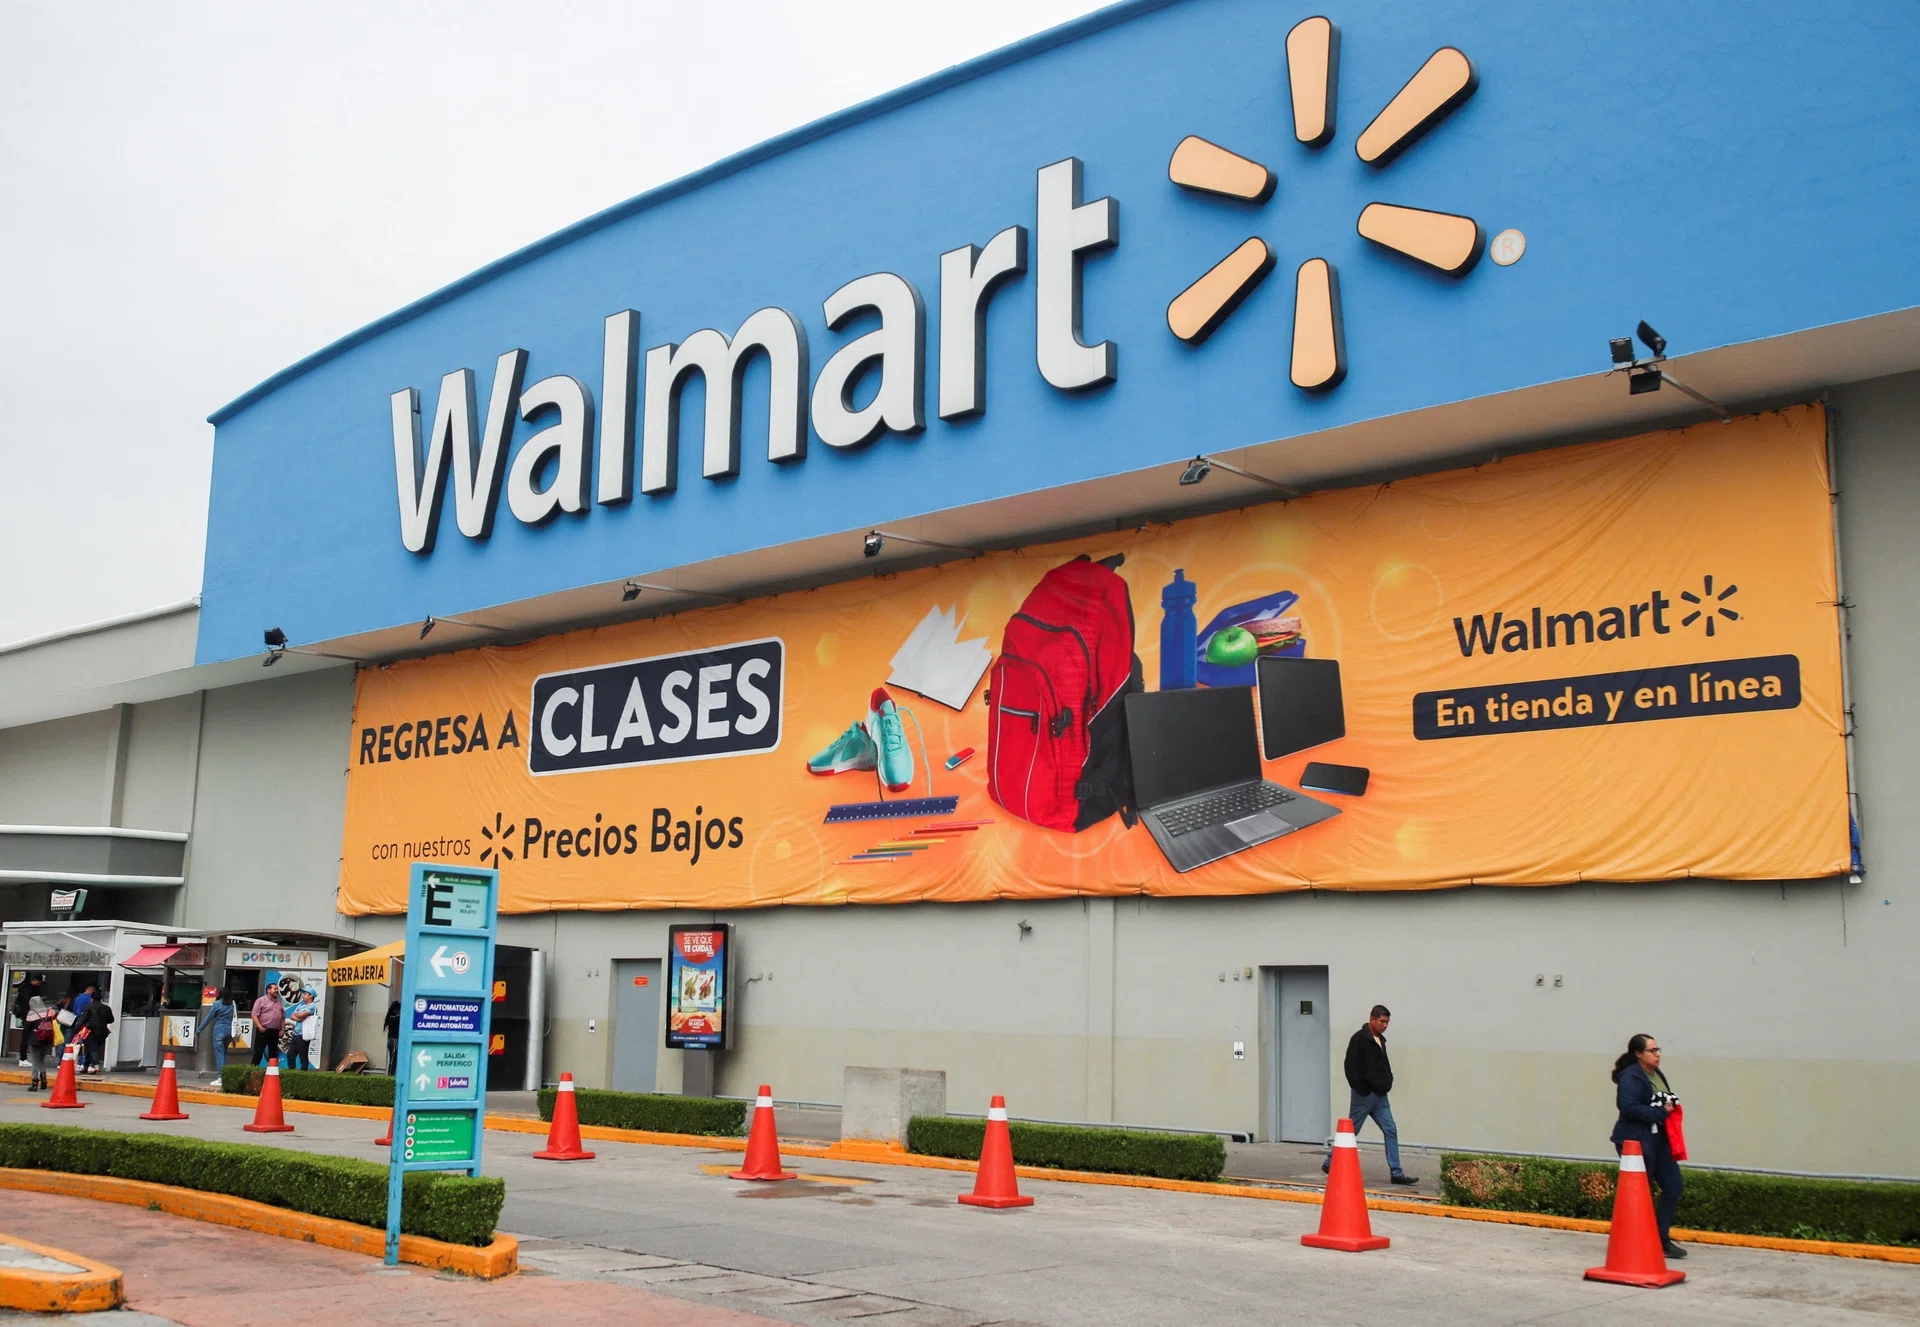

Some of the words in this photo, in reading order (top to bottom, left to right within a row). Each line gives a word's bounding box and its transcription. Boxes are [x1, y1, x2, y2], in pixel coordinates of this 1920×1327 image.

[390, 156, 1119, 555] Walmart
[1453, 590, 1670, 658] Walmart
[1436, 697, 1475, 728] En
[1485, 687, 1593, 723] tienda
[1604, 688, 1625, 722] y
[1634, 683, 1677, 710] en
[1690, 671, 1782, 704] línea
[359, 712, 489, 765] REGRESA
[497, 710, 520, 750] A
[540, 657, 771, 757] CLASES
[372, 839, 399, 861] con
[403, 834, 471, 859] nuestros
[523, 813, 638, 860] Precios
[650, 805, 744, 867] Bajos
[425, 884, 453, 926] E
[683, 936, 691, 945] SE
[692, 936, 699, 944] VE
[700, 936, 713, 945] QUE
[692, 945, 713, 953] CUIDAS
[241, 951, 291, 965] postres
[456, 957, 466, 966] 10
[331, 965, 384, 983] CERRAJERIA
[429, 1004, 478, 1012] AUTOMATIZADO
[183, 1025, 190, 1038] 15
[241, 1025, 250, 1034] 15
